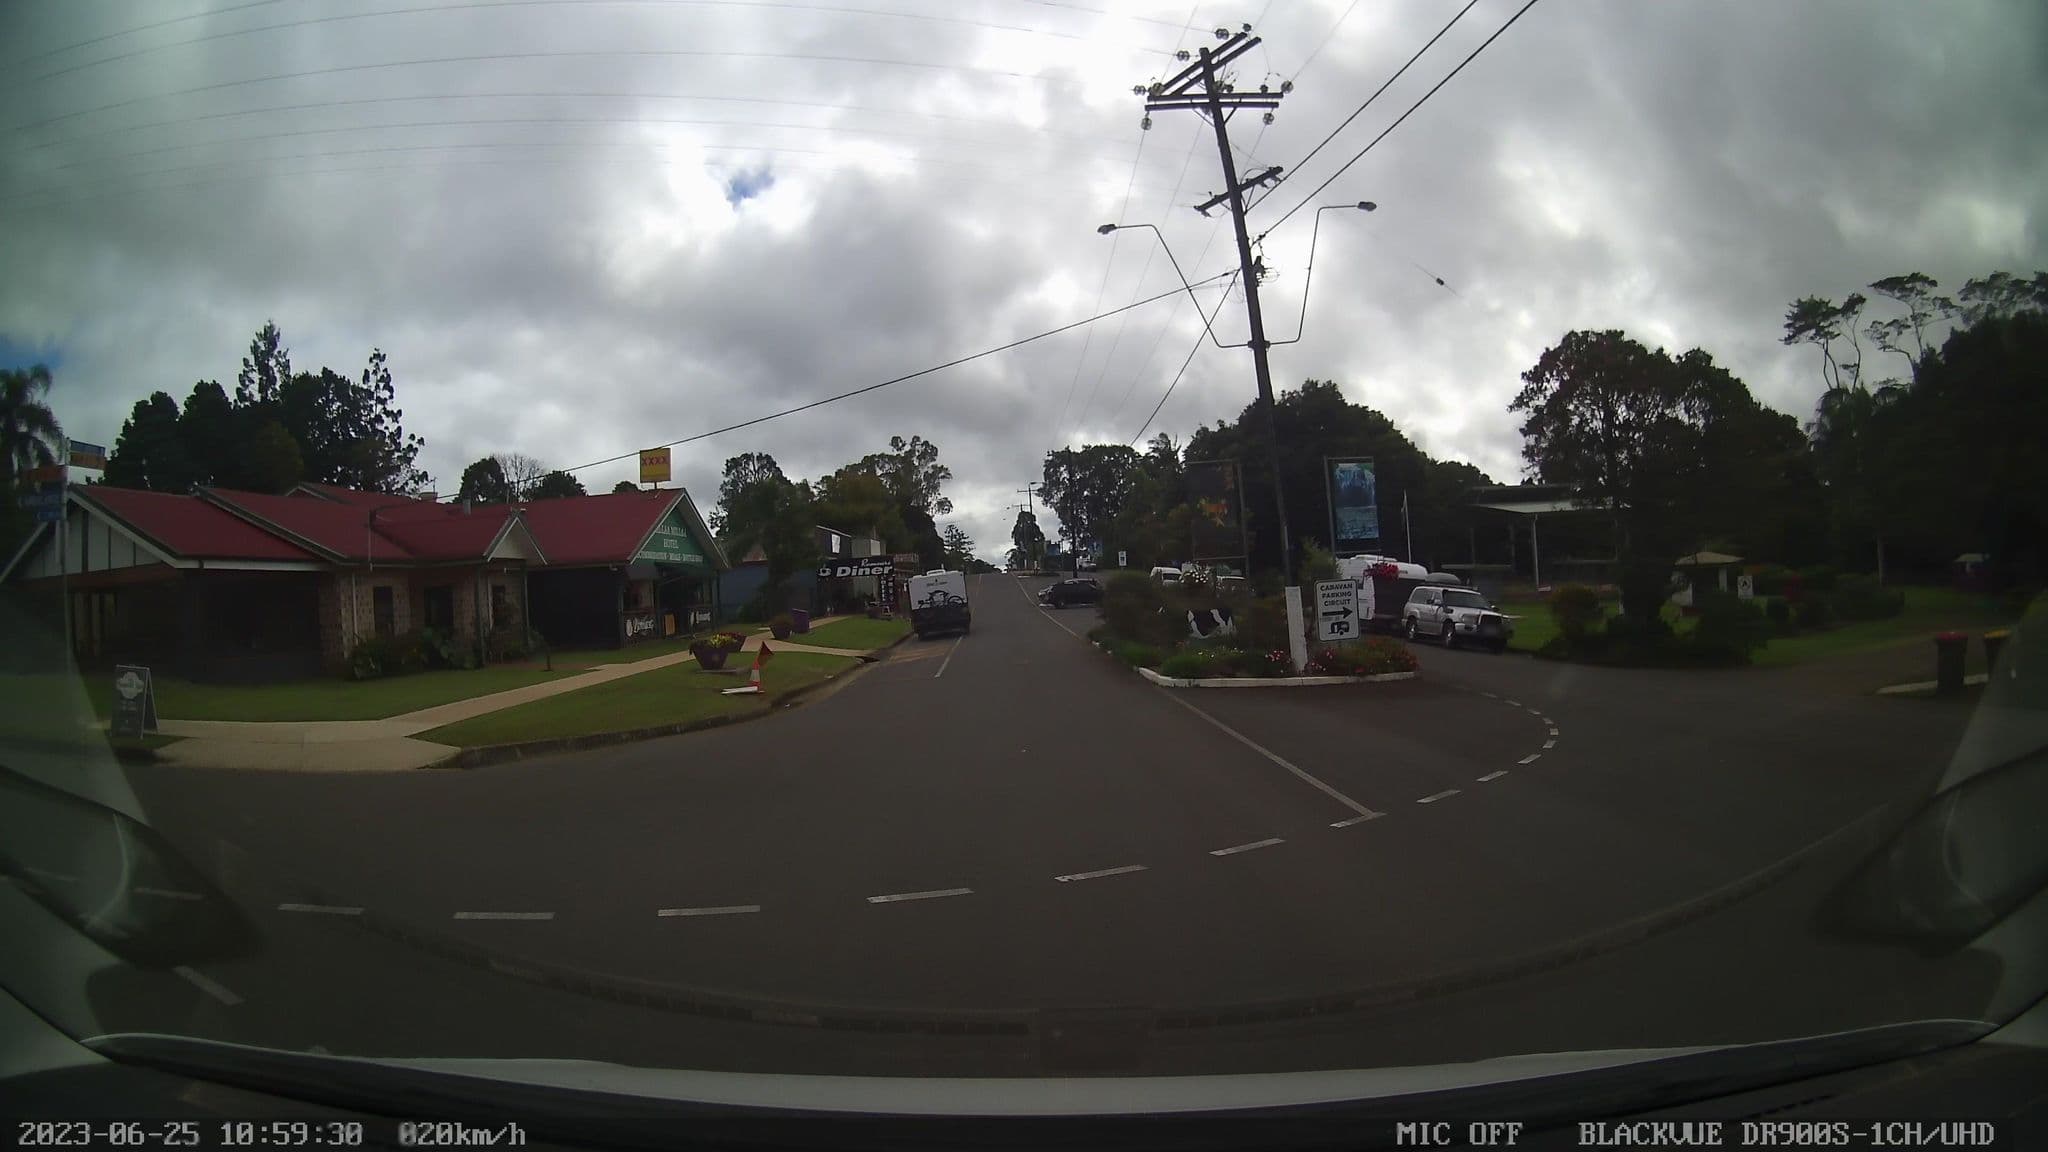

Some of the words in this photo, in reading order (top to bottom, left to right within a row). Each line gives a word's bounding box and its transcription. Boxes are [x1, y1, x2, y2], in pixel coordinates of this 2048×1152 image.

[836, 566, 893, 577] Diner
[1320, 583, 1353, 591] CARAVAN
[1322, 591, 1352, 599] PARKING
